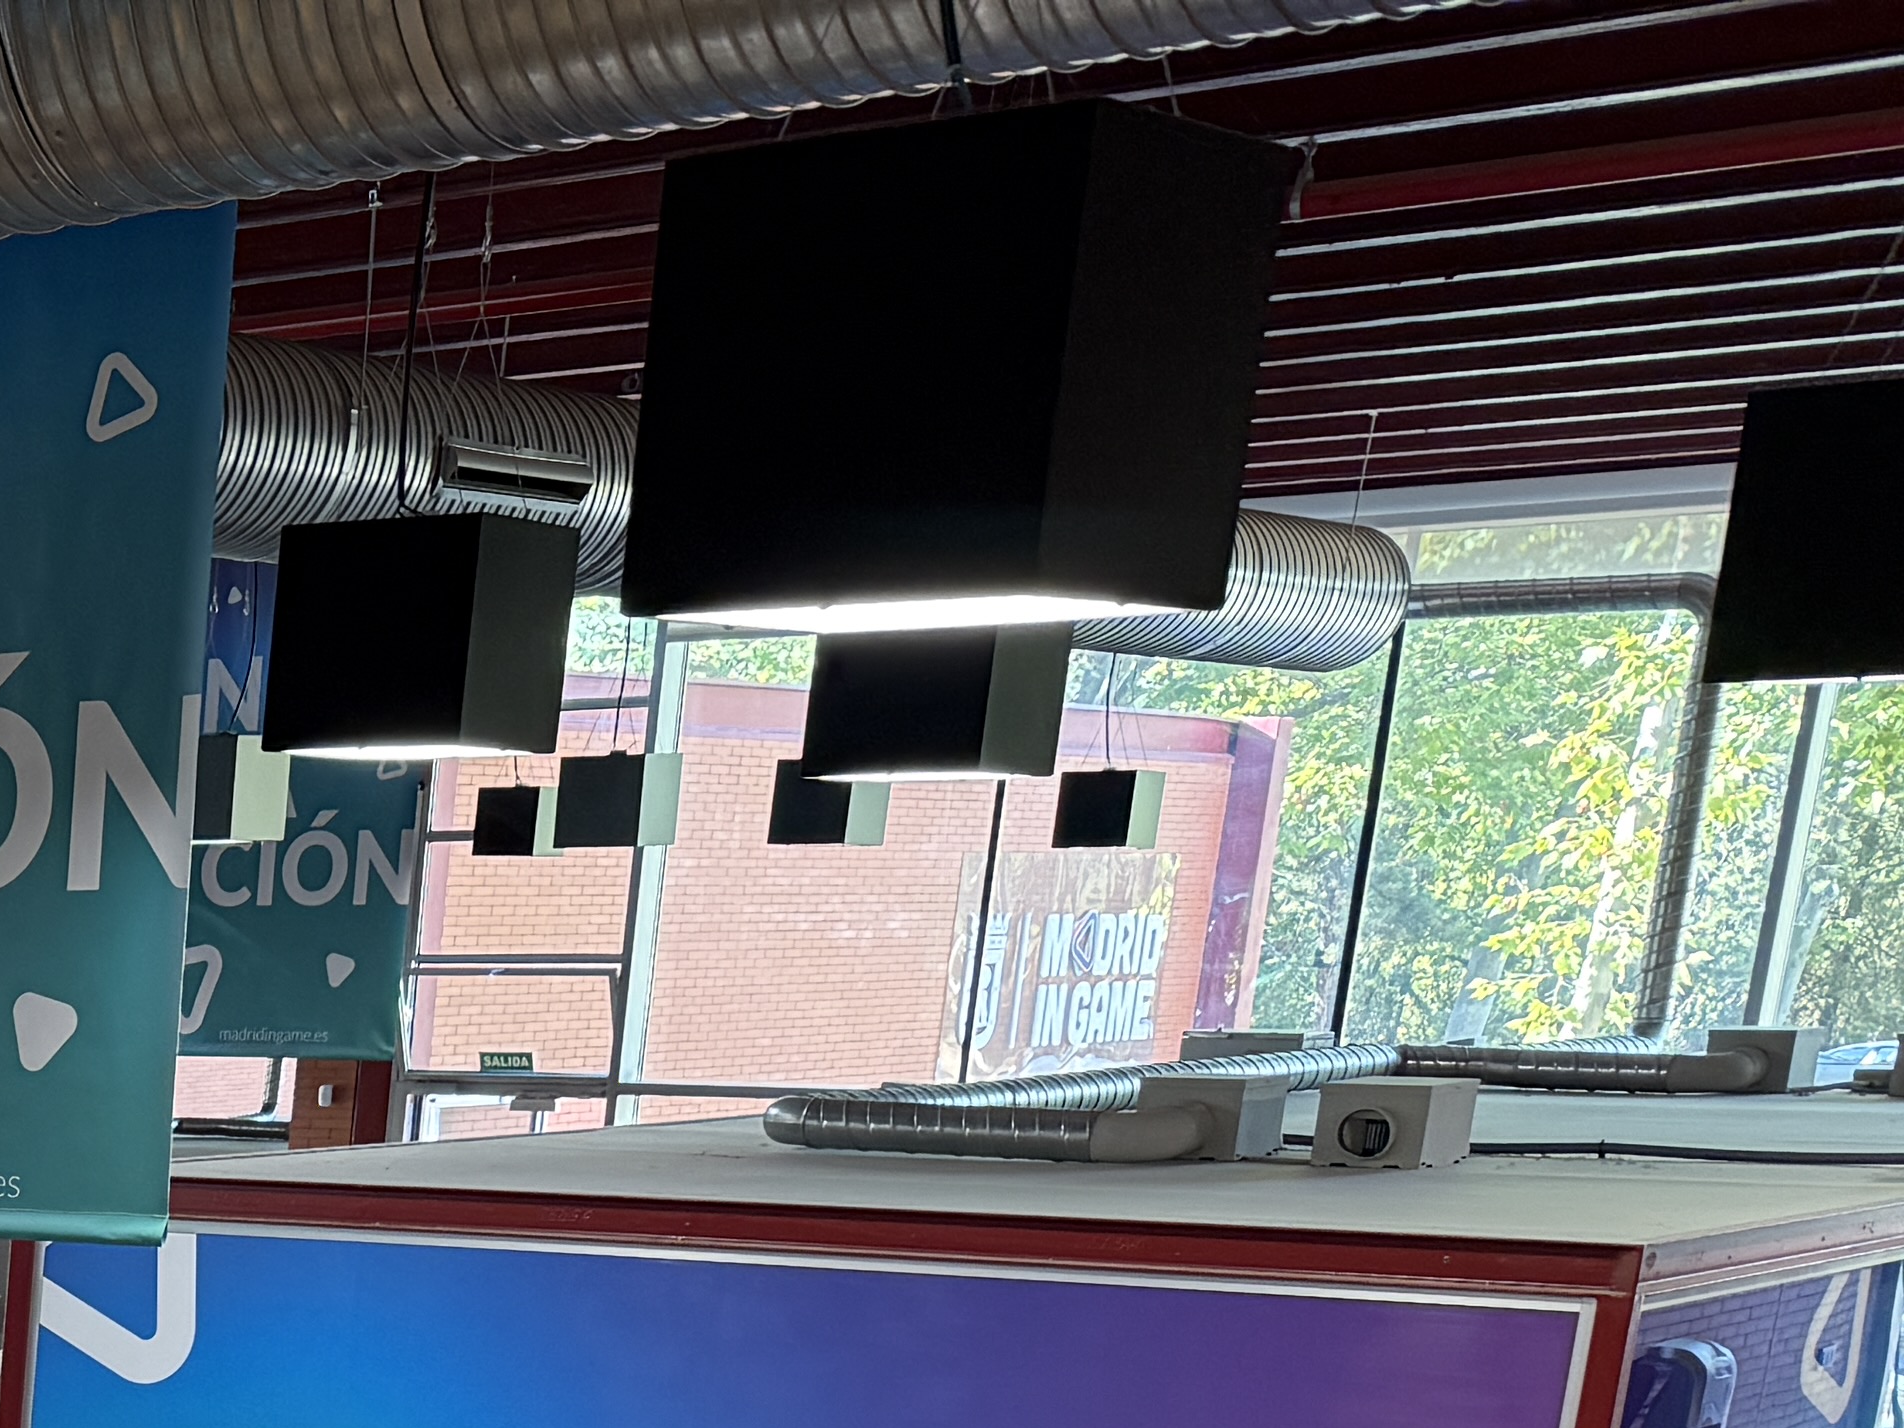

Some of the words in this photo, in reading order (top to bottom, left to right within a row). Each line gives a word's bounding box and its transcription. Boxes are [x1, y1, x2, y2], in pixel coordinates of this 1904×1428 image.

[1031, 981, 1065, 1047] IN
[1068, 978, 1156, 1045] GAME
[483, 1053, 530, 1070] SALIDA
